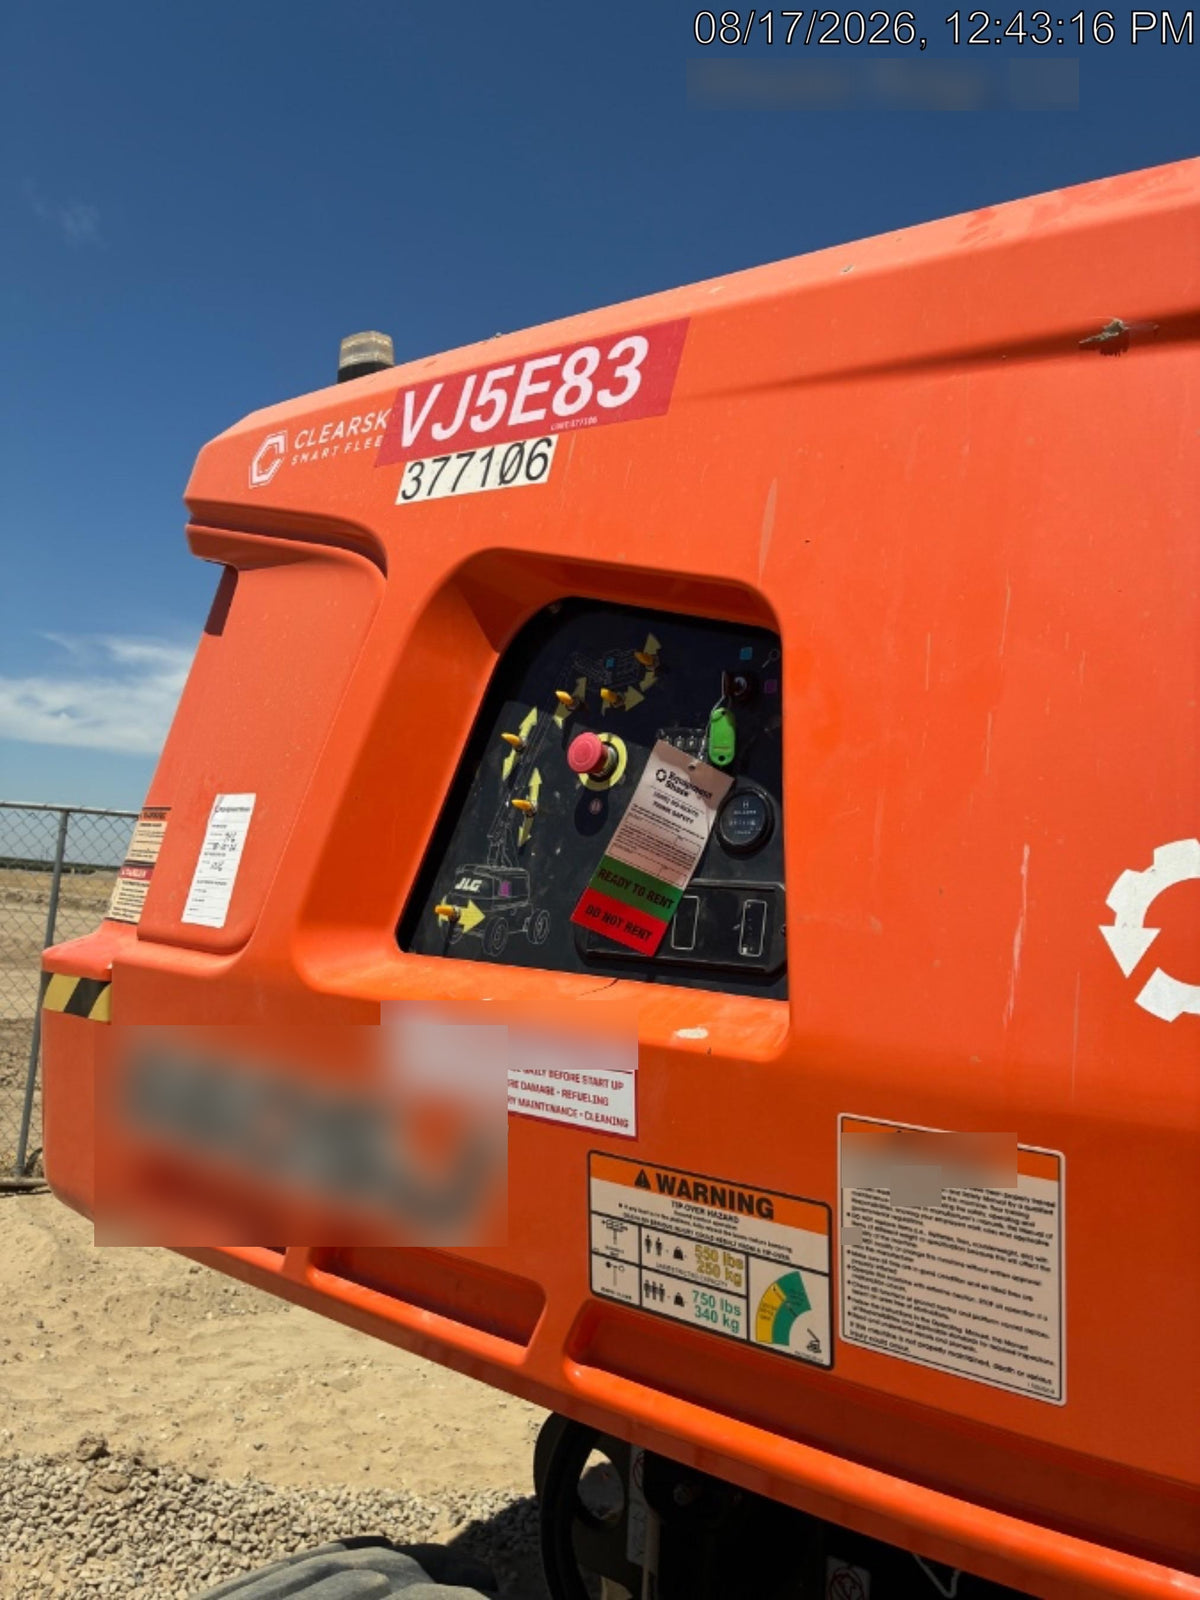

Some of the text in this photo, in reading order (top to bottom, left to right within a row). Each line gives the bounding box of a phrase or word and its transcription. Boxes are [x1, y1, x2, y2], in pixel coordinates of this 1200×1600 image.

[401, 335, 649, 448] VJ5E83
[294, 408, 392, 449] CLEARSK
[291, 434, 384, 466] SMART FLEE
[401, 436, 553, 500] 377106
[454, 877, 483, 892] JLG
[598, 868, 674, 910] READY TO RENT
[585, 903, 653, 942] DO NOT RENT
[520, 1081, 555, 1096] DAMAGE
[561, 1088, 609, 1106] REFUELING
[548, 1070, 580, 1084] BEFORE
[582, 1075, 609, 1089] START
[611, 1079, 625, 1091] UP
[518, 1097, 578, 1119] MAINTENANCE
[584, 1110, 629, 1128] CLEANING
[656, 1173, 774, 1220] WARNING
[706, 1209, 739, 1224] HAZARD
[695, 1244, 744, 1270] 550 lbs
[697, 1260, 742, 1287] 250 kg
[692, 1290, 716, 1309] 750
[720, 1297, 741, 1316] lbs
[694, 1304, 740, 1334] 340 kg
